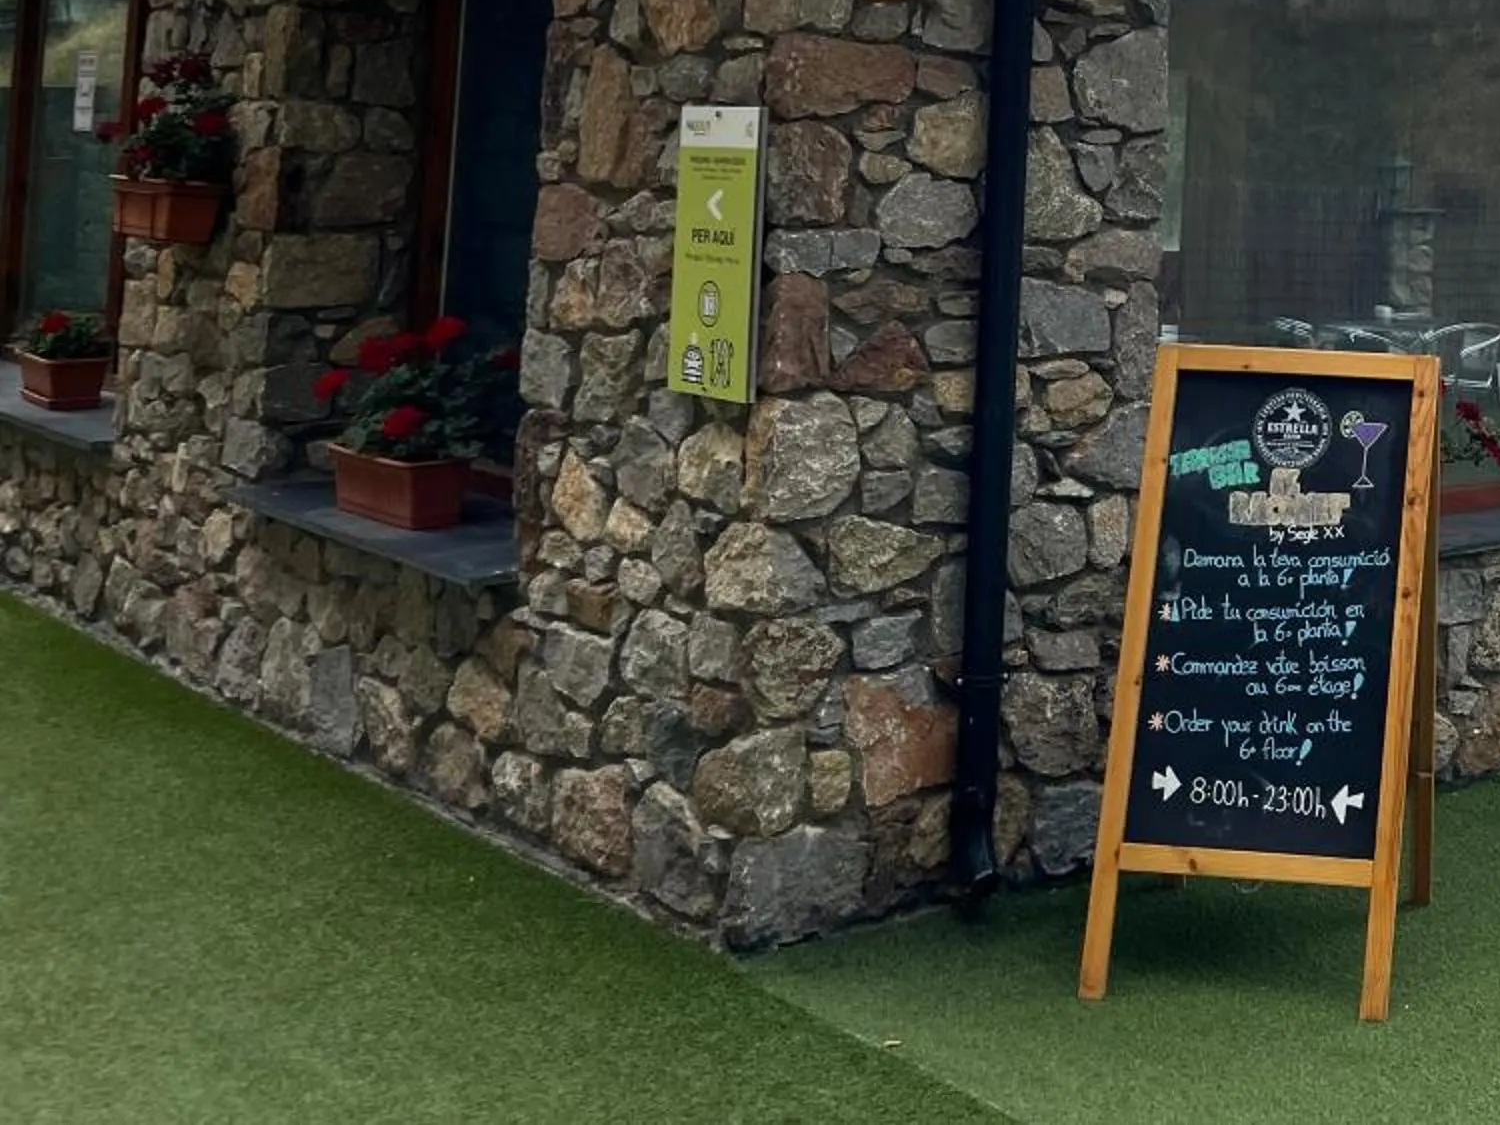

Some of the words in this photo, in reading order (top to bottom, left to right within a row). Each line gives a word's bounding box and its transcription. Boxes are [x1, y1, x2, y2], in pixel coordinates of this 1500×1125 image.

[692, 228, 710, 244] PER
[712, 227, 736, 245] AQUÍ
[1267, 422, 1318, 435] ESTRELLA
[1269, 526, 1284, 544] by
[1287, 525, 1318, 544] Segle
[1183, 548, 1244, 568] Demana
[1253, 544, 1266, 567] la
[1270, 547, 1302, 567] teva
[1237, 574, 1250, 588] a
[1259, 569, 1271, 587] la
[1221, 592, 1242, 620] tu
[1345, 604, 1365, 619] en
[1254, 621, 1268, 643] la
[1309, 649, 1366, 673] boisson
[1245, 681, 1269, 696] au
[1164, 708, 1215, 735] Order
[1221, 719, 1252, 747] your
[1259, 710, 1298, 735] drink
[1305, 721, 1324, 734] on
[1326, 709, 1352, 732] the
[1189, 776, 1248, 807] 8:00h
[1262, 784, 1326, 819] 23:00h
